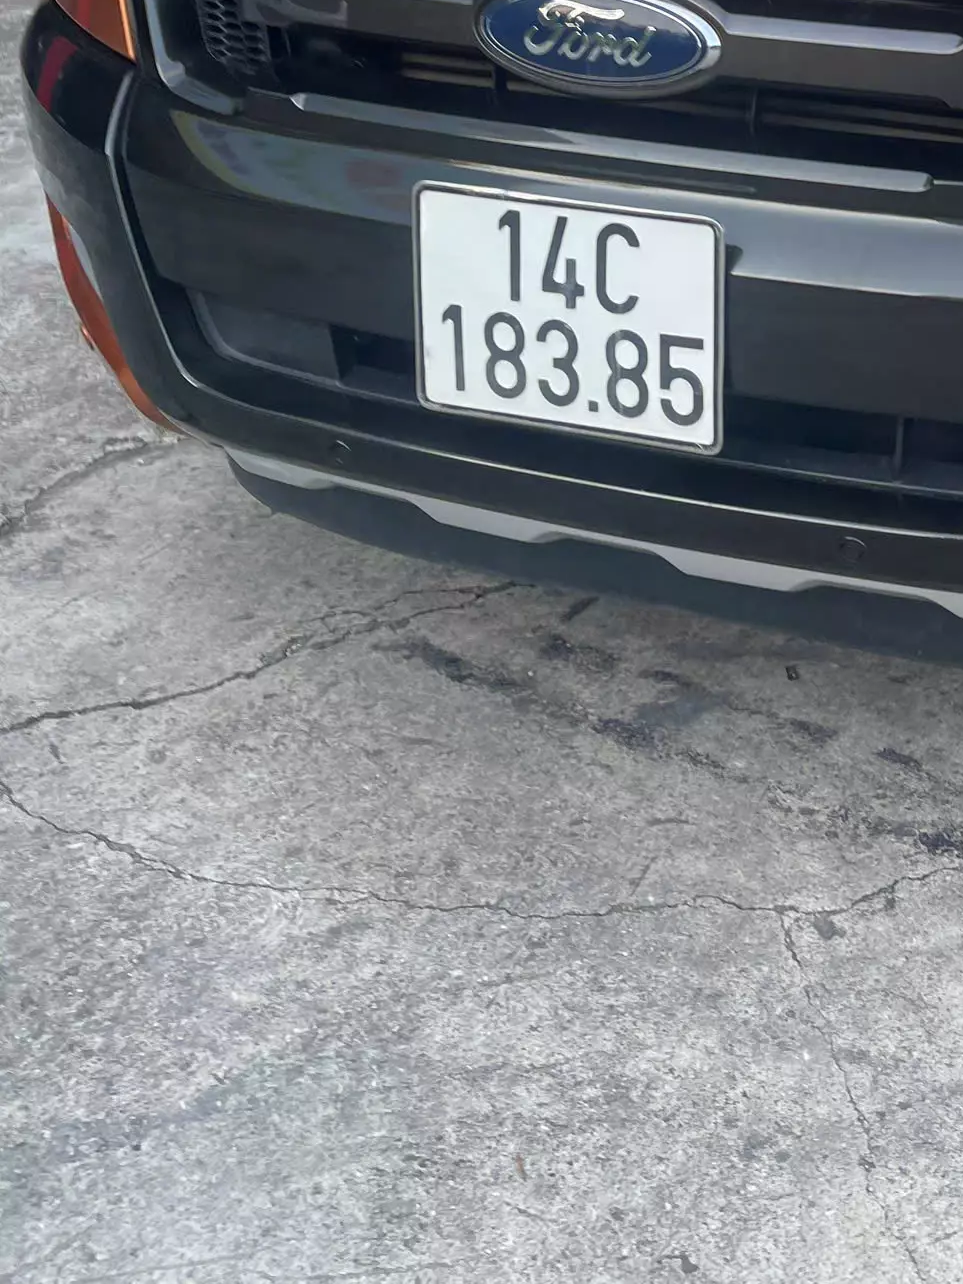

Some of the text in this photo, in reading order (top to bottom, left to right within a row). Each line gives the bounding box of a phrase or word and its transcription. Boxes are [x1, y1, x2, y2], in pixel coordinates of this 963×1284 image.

[523, 0, 657, 67] Ford
[498, 209, 640, 314] 14C
[441, 304, 704, 426] 183.85
